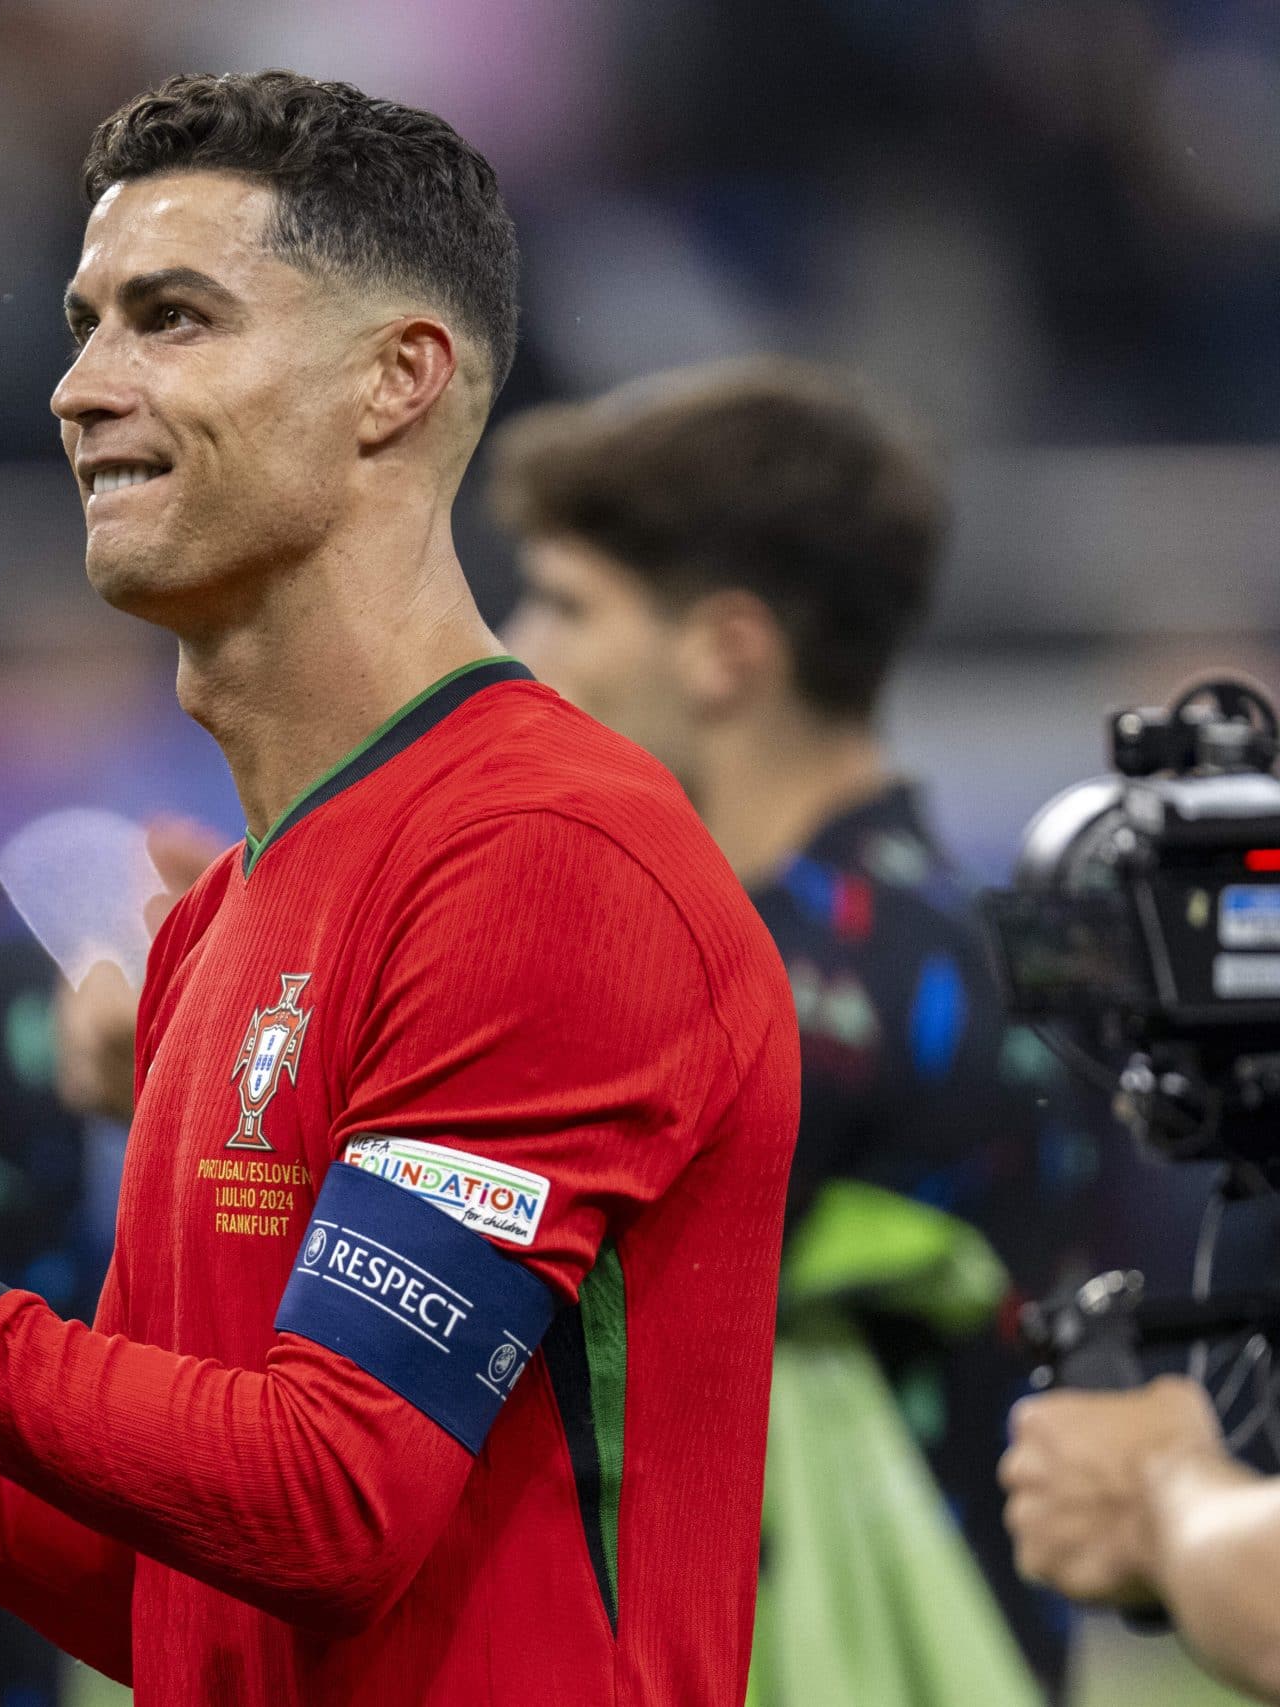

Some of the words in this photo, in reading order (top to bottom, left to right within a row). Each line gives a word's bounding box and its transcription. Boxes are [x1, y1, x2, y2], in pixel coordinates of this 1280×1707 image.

[351, 1135, 390, 1154] UEFA
[259, 1189, 294, 1211] 2024
[348, 1153, 538, 1220] FOUNDATION
[215, 1213, 289, 1236] FRANKFURT
[463, 1207, 480, 1223] for
[483, 1216, 528, 1238] children
[328, 1240, 467, 1338] RESPECT
